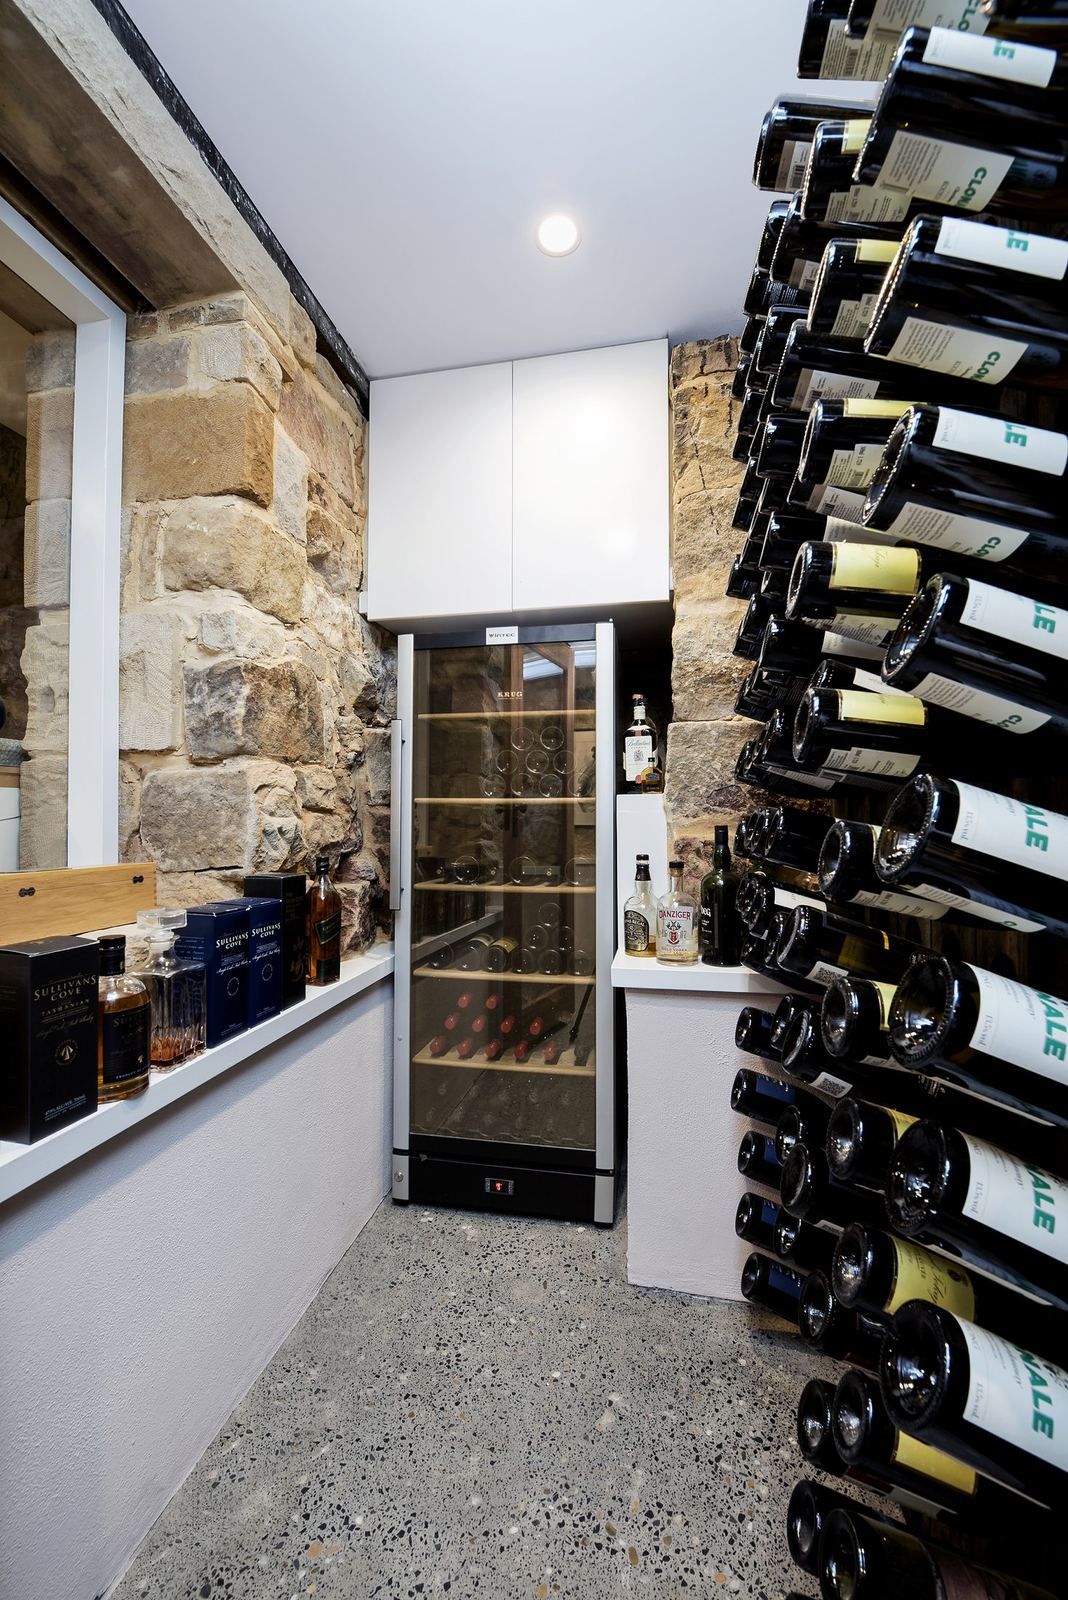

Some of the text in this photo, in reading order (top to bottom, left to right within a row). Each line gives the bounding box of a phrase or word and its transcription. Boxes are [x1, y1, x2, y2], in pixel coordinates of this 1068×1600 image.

[659, 910, 691, 921] DANZIGER
[251, 922, 281, 937] SULLIVANS
[260, 929, 275, 938] COVE
[215, 931, 249, 949] SULLIVANS
[225, 940, 242, 950] COVE
[34, 974, 97, 1001] SULLIVANS
[51, 987, 82, 1002] COVE
[41, 998, 90, 1017] TASMANIAN
